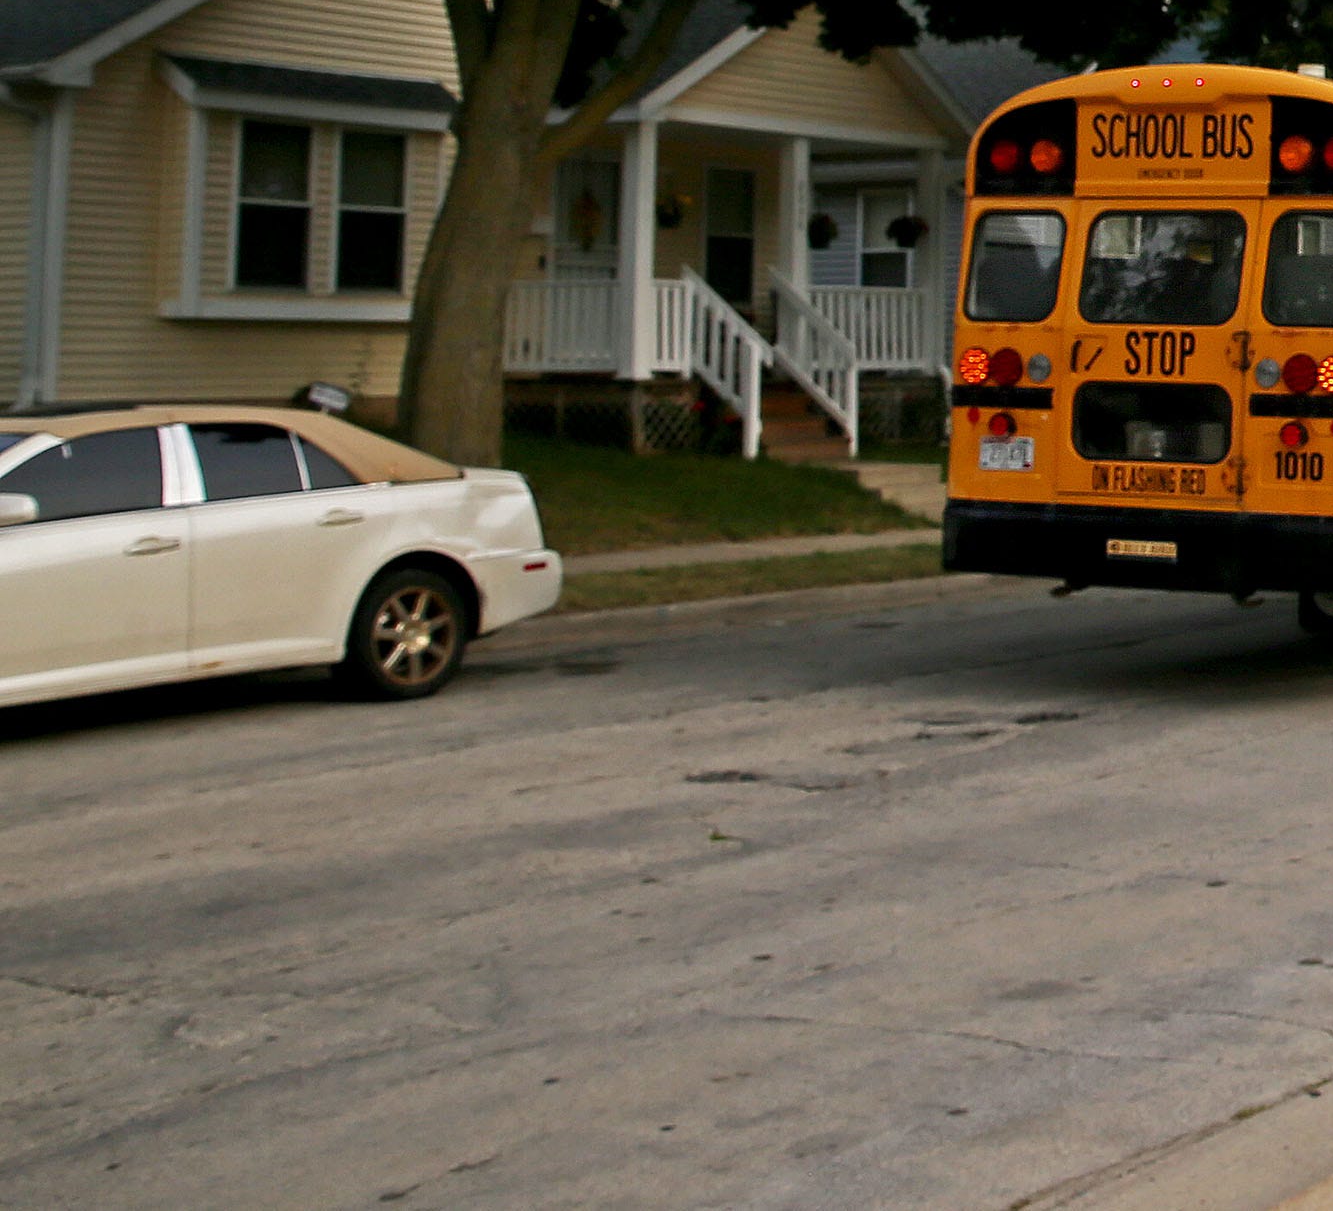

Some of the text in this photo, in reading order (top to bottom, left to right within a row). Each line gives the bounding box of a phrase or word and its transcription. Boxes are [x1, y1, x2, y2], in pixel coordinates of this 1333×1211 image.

[1092, 113, 1254, 159] SCHOOL BUS
[1125, 331, 1195, 376] STOP
[1113, 465, 1175, 493] FLASHING
[1180, 469, 1206, 494] RED
[1275, 451, 1324, 481] 1010
